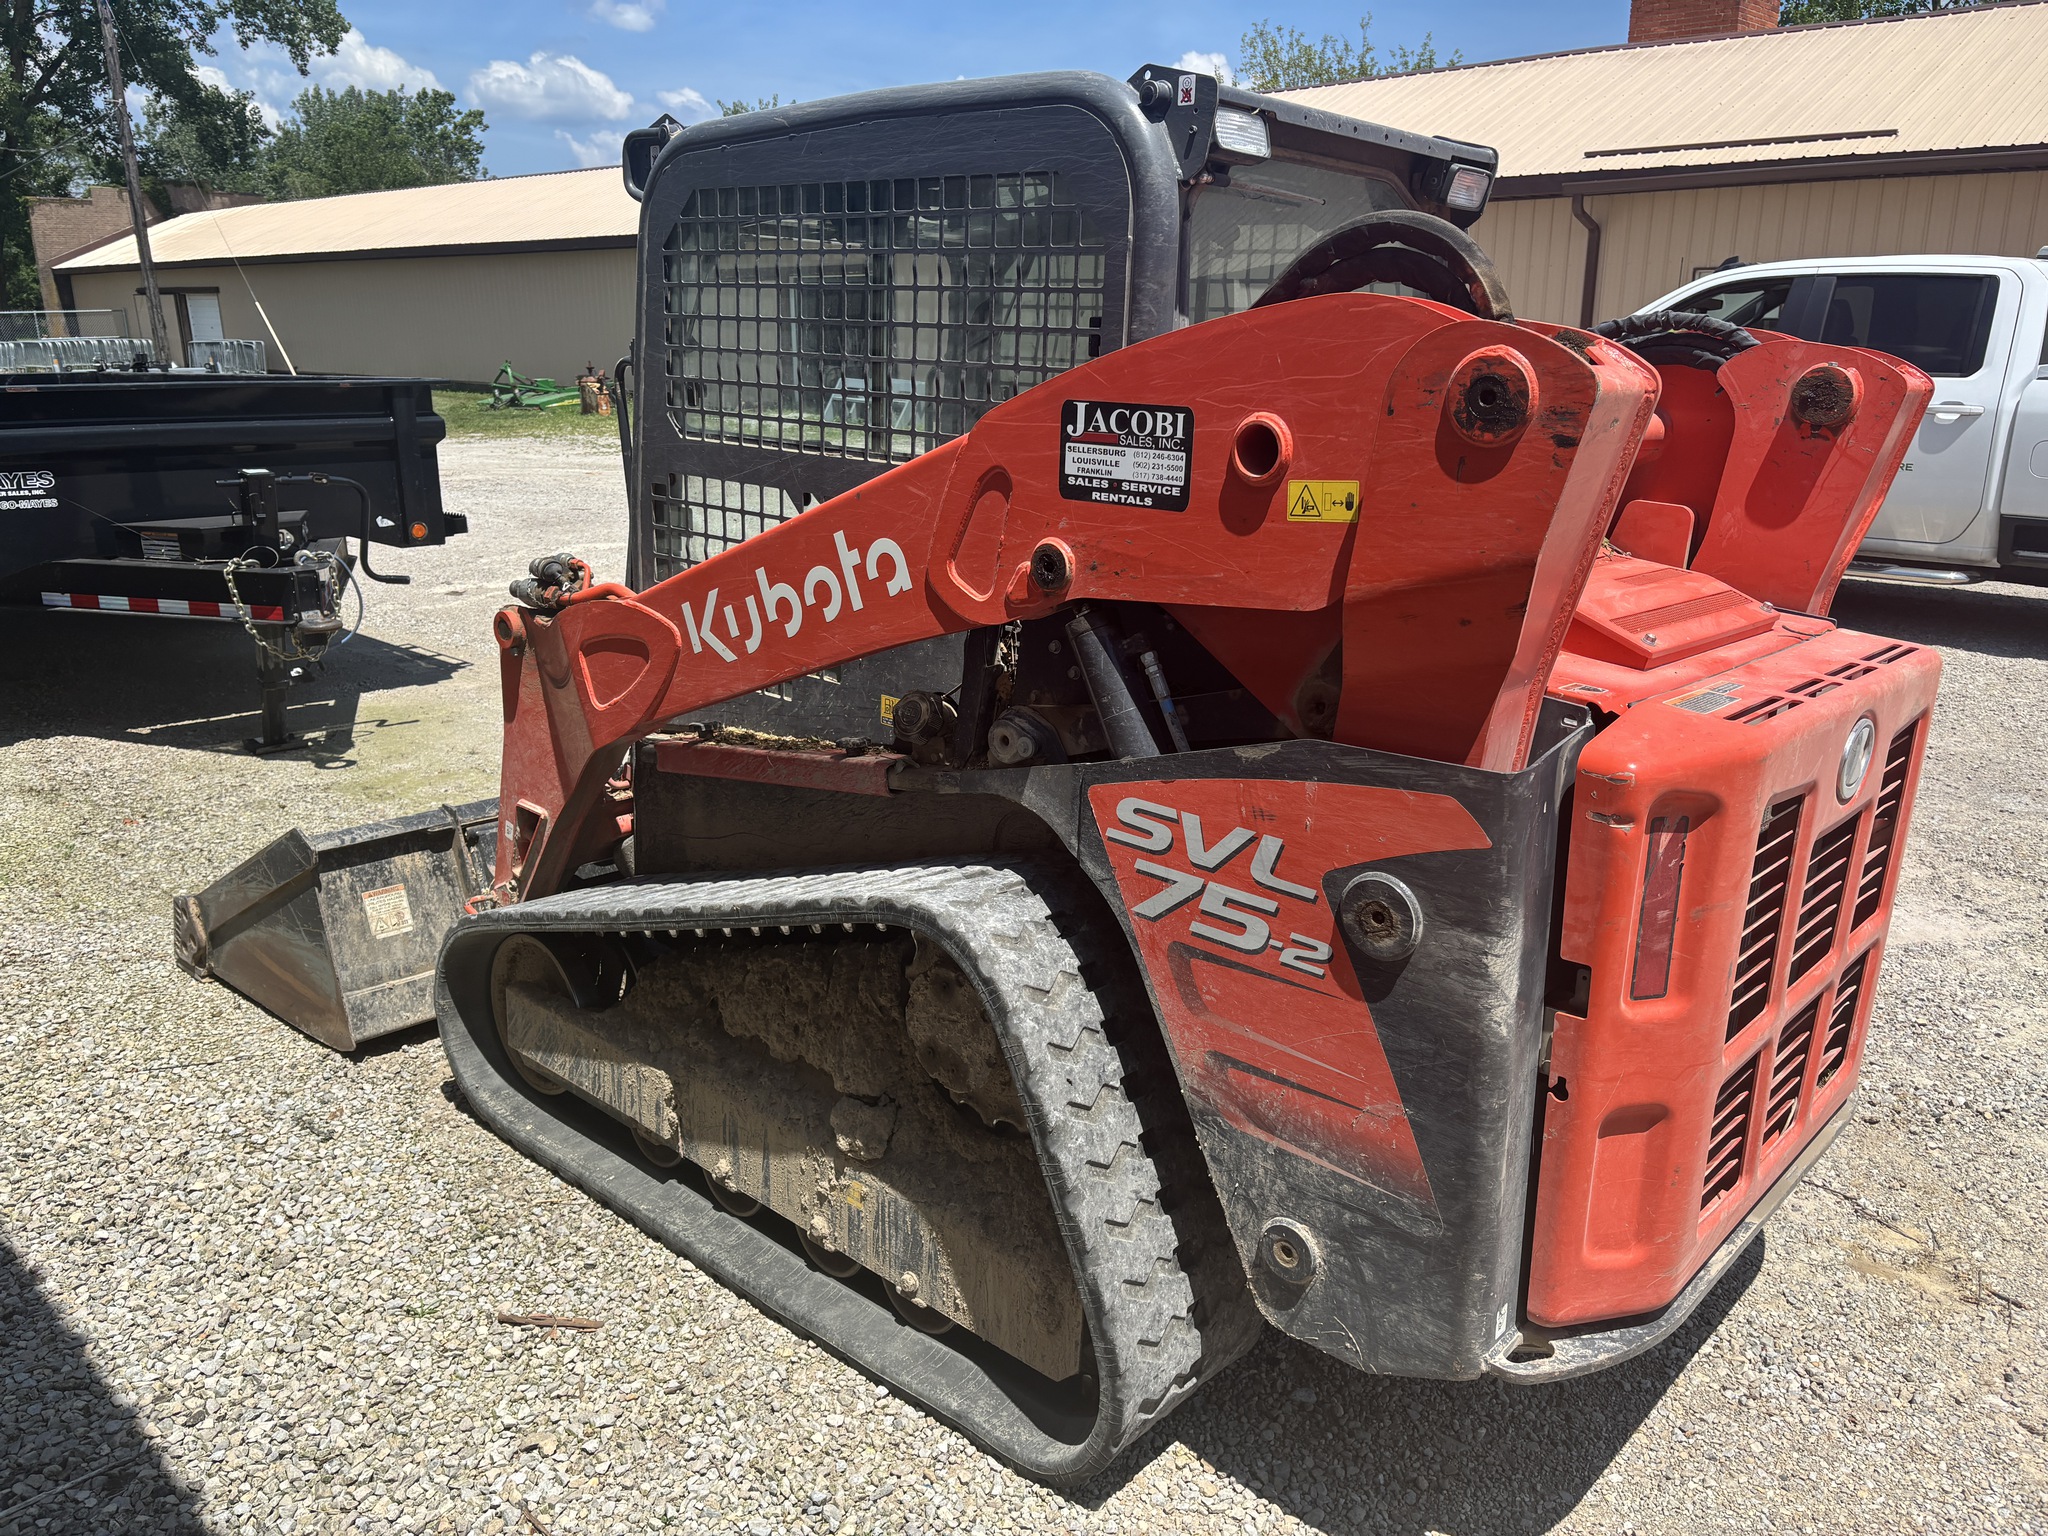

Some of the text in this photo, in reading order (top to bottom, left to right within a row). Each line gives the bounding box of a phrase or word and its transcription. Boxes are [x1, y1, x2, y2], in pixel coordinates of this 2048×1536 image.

[1066, 401, 1186, 439] JACOBI
[1119, 435, 1185, 450] SALES, INC.
[1067, 445, 1184, 462] SELLERSBURG (812) 246-6304
[1072, 456, 1184, 472] LOUISVILLE (502) 231-5500
[1077, 467, 1183, 483] FRANKLIN (317) 738-4440
[1067, 476, 1181, 496] SALES SERVICE
[1092, 491, 1153, 506] RENTALS
[681, 529, 913, 663] Kubota
[1105, 797, 1318, 902] SVL
[1130, 858, 1333, 978] 75-2
